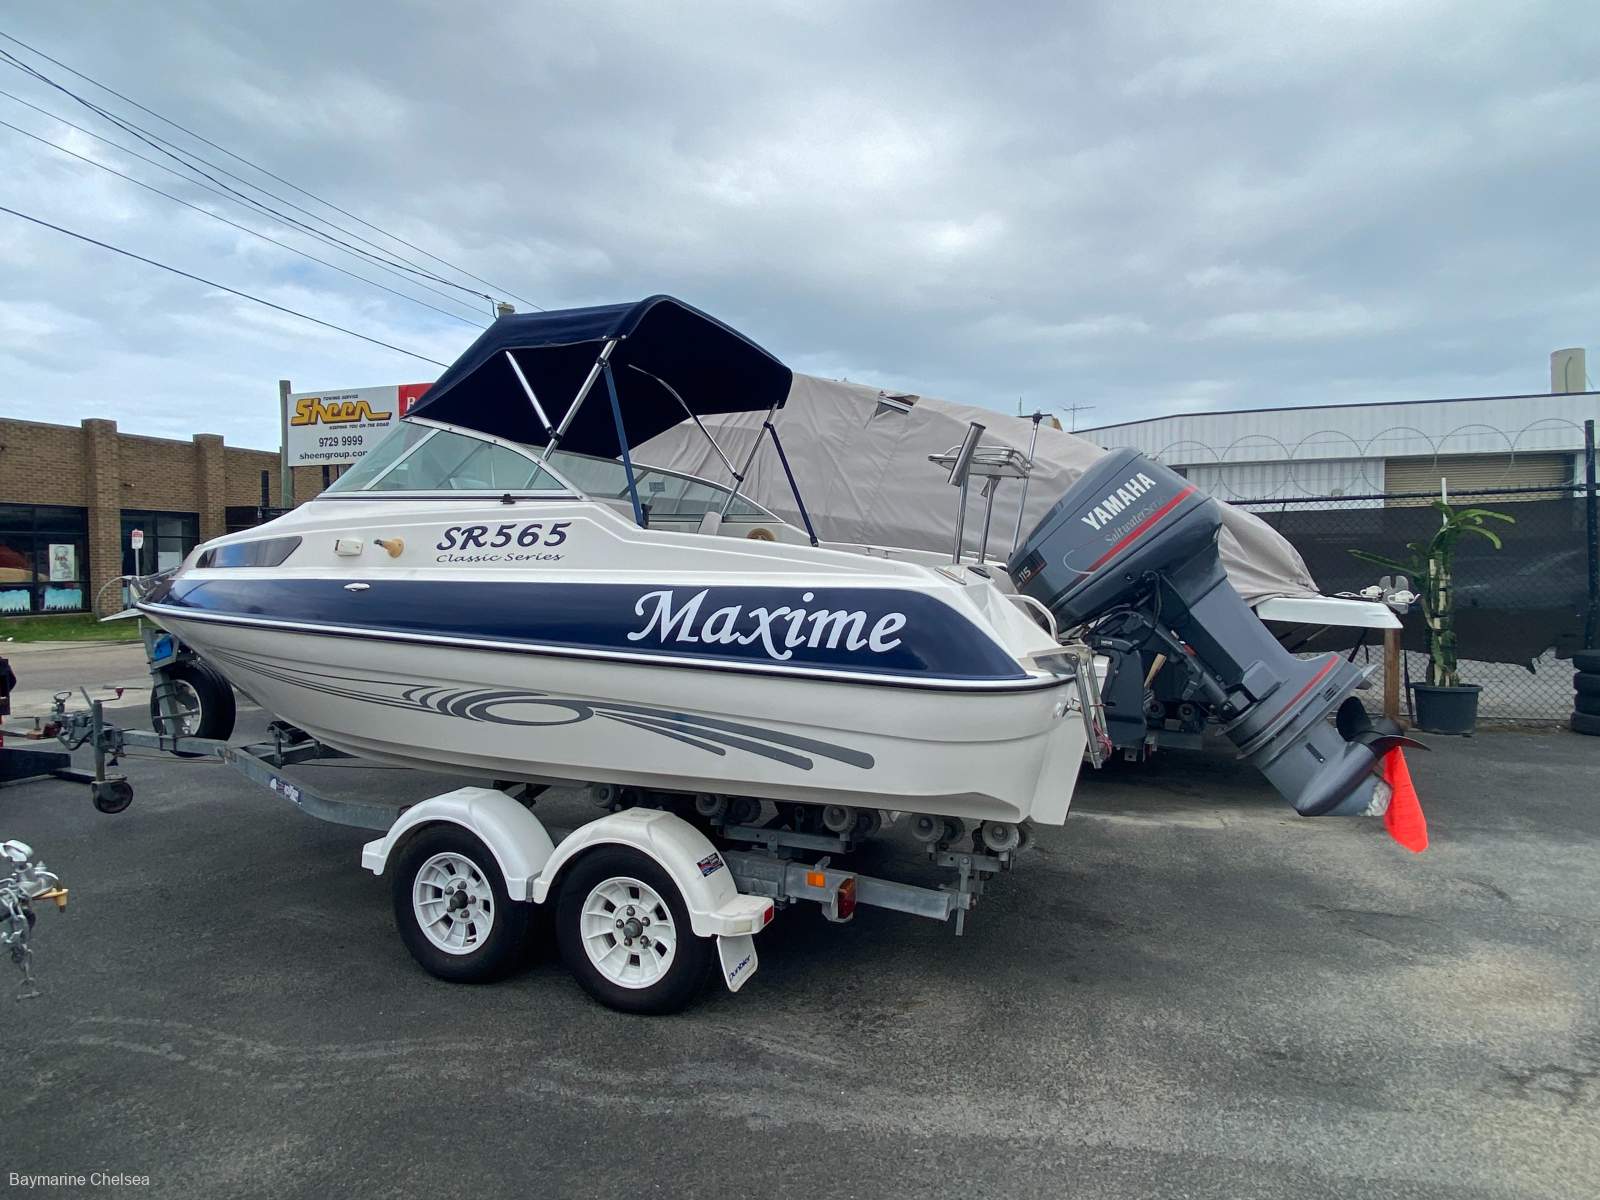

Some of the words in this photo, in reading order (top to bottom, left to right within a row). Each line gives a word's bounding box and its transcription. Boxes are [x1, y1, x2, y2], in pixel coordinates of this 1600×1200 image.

[291, 398, 392, 426] Sheen
[318, 436, 339, 448] 9729
[341, 435, 363, 447] 9999
[1081, 472, 1156, 530] YAMAHA
[436, 522, 572, 551] SR565
[436, 553, 501, 563] Classic
[503, 552, 565, 562] Series
[1018, 566, 1031, 583] 115
[627, 588, 907, 661] Maxime
